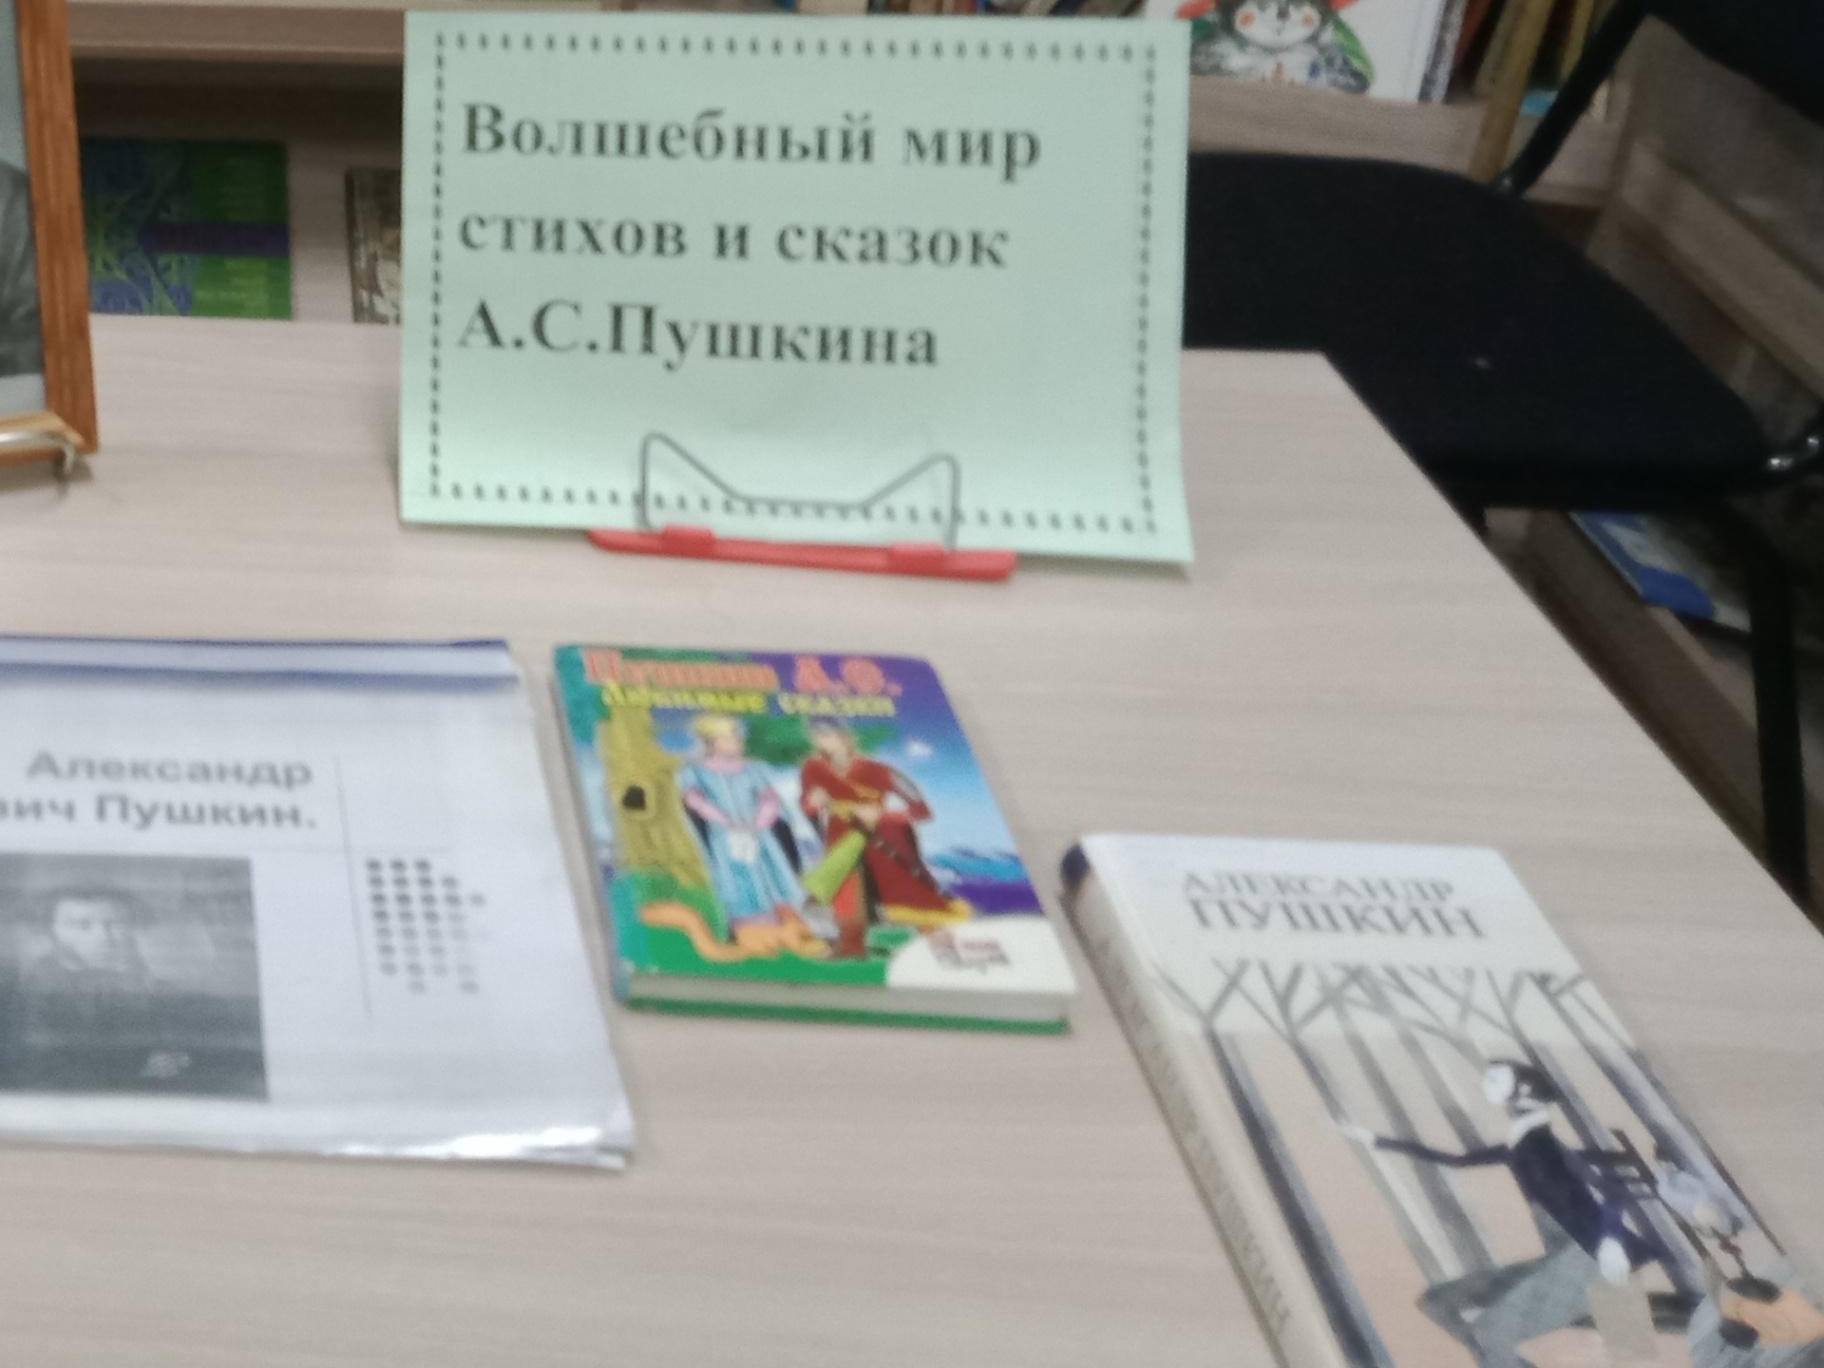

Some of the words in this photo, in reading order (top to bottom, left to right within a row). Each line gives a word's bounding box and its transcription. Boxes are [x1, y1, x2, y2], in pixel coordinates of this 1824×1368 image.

[460, 101, 877, 167] Волшебный
[902, 124, 1043, 184] мир
[458, 212, 689, 261] стихов
[713, 220, 753, 262] и
[776, 223, 1012, 270] сказок
[456, 299, 941, 373] А.С.Пушкина
[26, 750, 314, 792] Александр
[94, 792, 319, 832] Пушкин.
[1181, 871, 1456, 902] АЛЕКСАНДР
[1188, 897, 1488, 939] ПУШКИН
